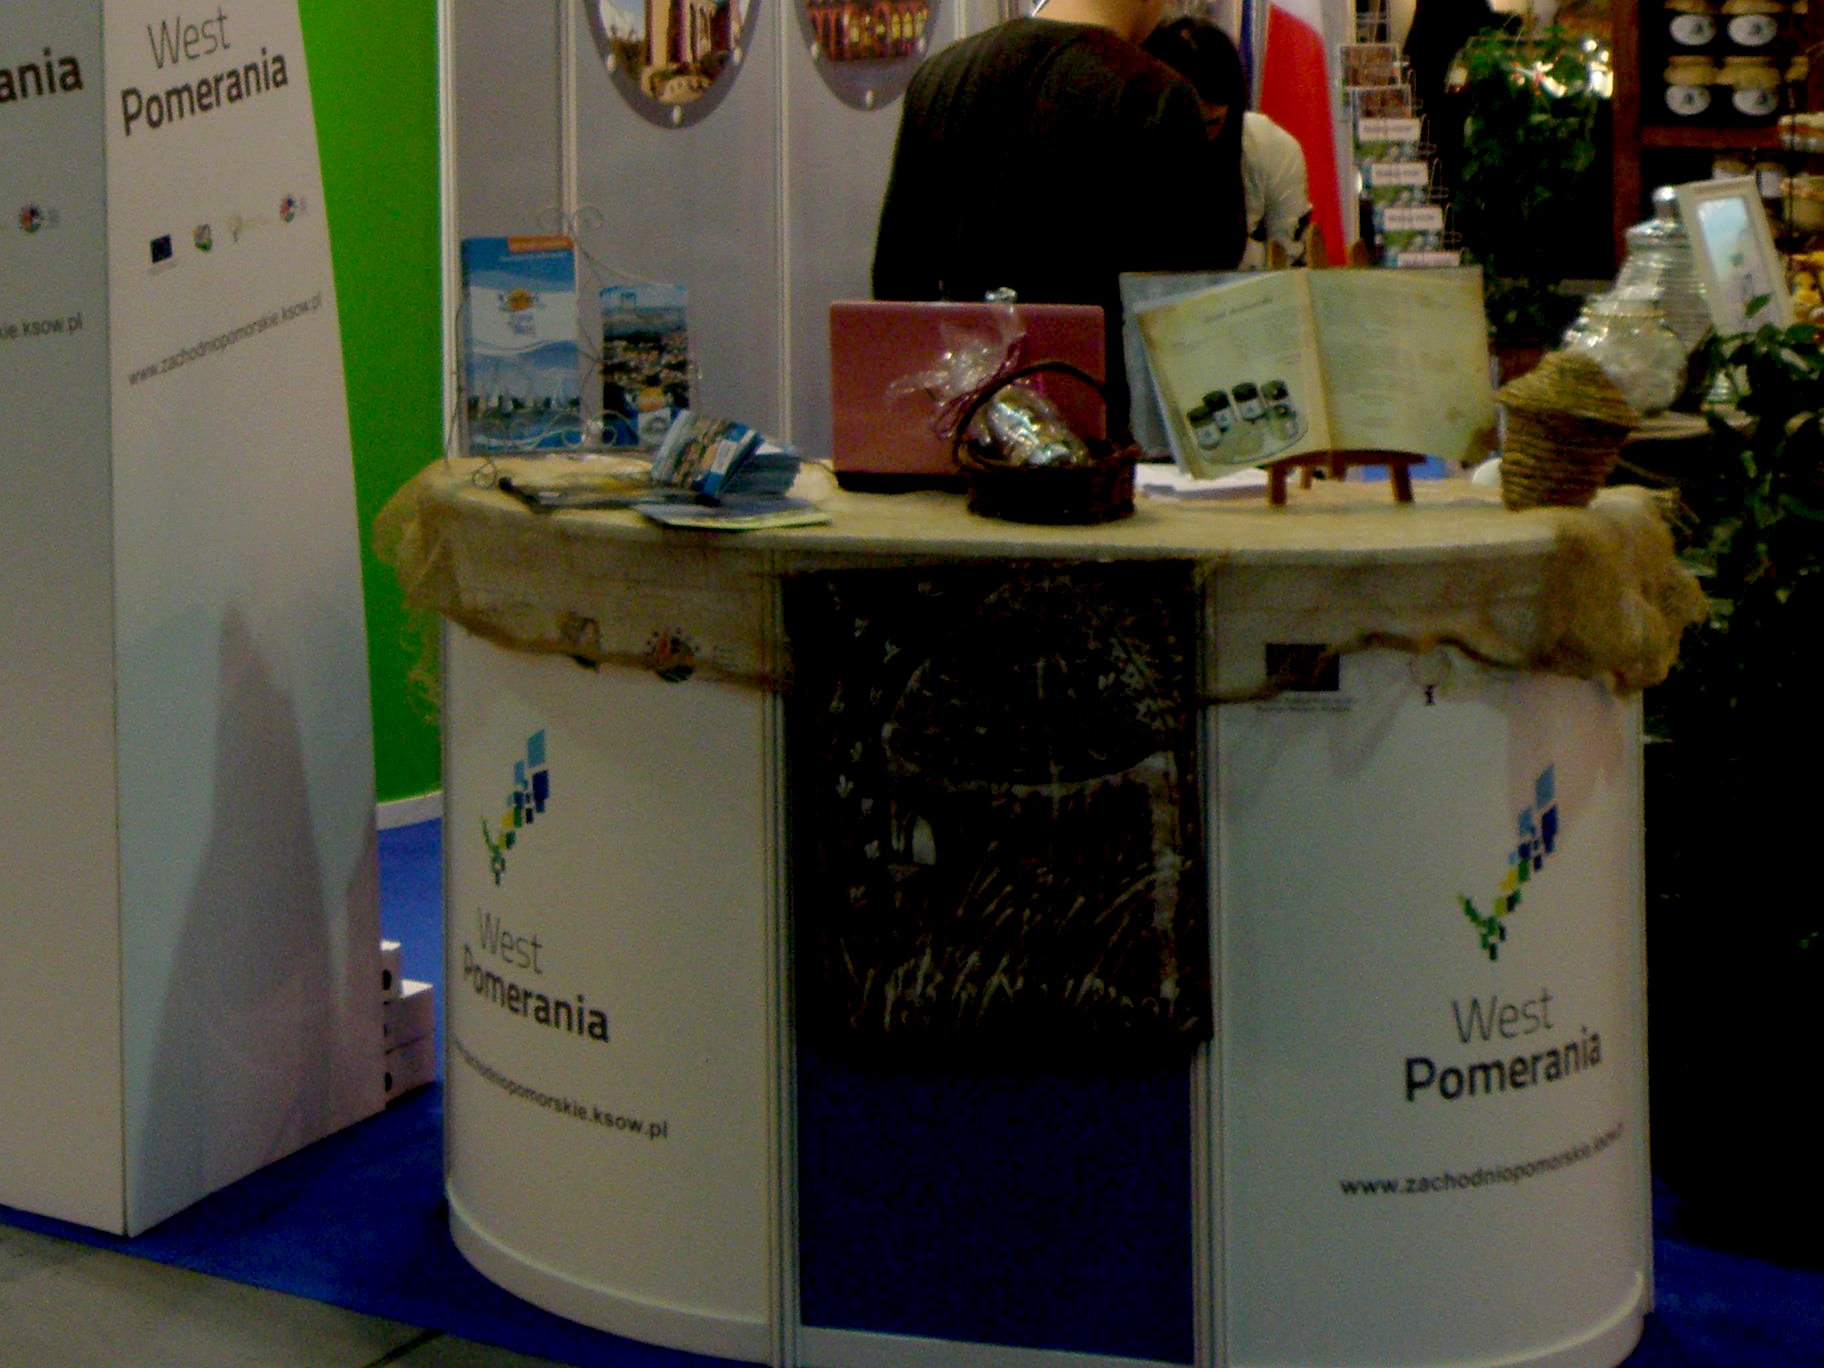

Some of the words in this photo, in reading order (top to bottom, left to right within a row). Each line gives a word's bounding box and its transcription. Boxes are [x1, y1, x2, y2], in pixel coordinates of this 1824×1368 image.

[147, 6, 232, 70] West
[121, 46, 289, 137] Pomerania
[478, 907, 544, 975] West
[461, 944, 610, 1044] Pomerania
[1452, 986, 1554, 1045] West
[1405, 1025, 1602, 1102] Pomerania
